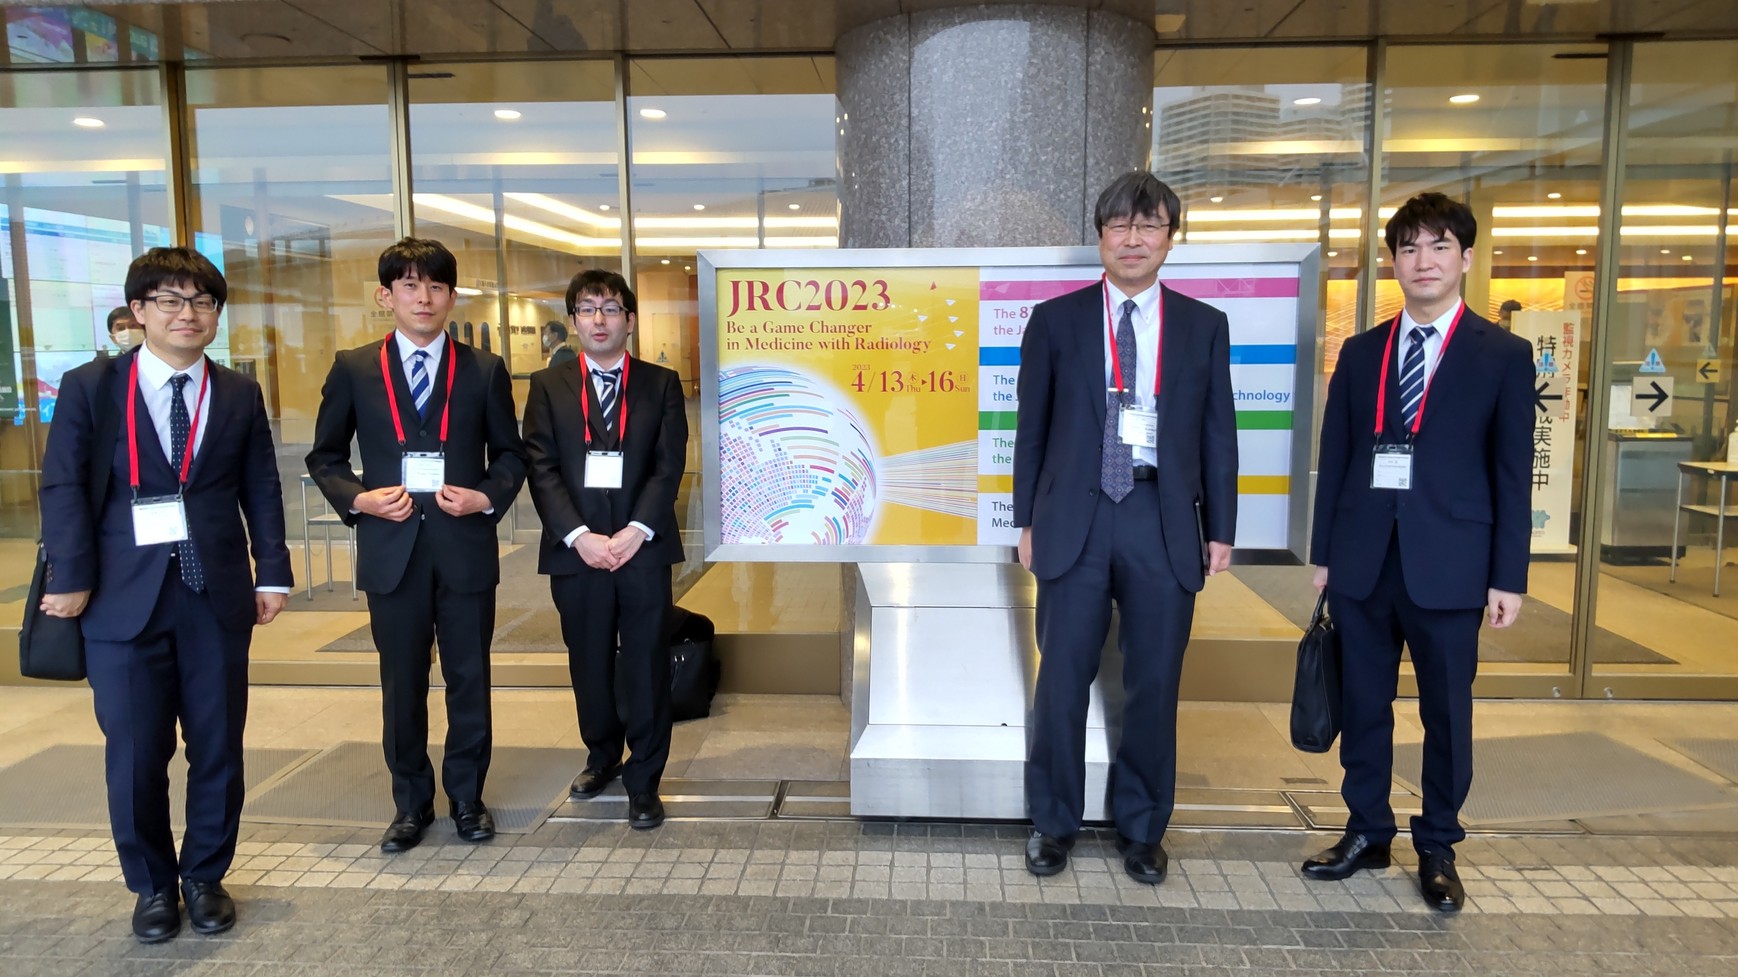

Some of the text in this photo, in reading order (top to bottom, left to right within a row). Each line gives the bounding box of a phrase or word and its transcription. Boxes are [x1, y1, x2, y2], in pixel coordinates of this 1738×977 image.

[726, 279, 891, 317] JRC2023
[993, 308, 1016, 319] The
[726, 320, 872, 337] Be a Game Changer
[993, 325, 1014, 336] the
[726, 337, 931, 354] in Medicine with Radiology
[905, 384, 921, 393] Thu
[929, 370, 955, 393] 16
[955, 385, 971, 393] Sun
[993, 374, 1015, 385] The
[993, 391, 1013, 401] the
[992, 437, 1014, 448] The
[992, 453, 1012, 464] the
[992, 501, 1014, 511] The
